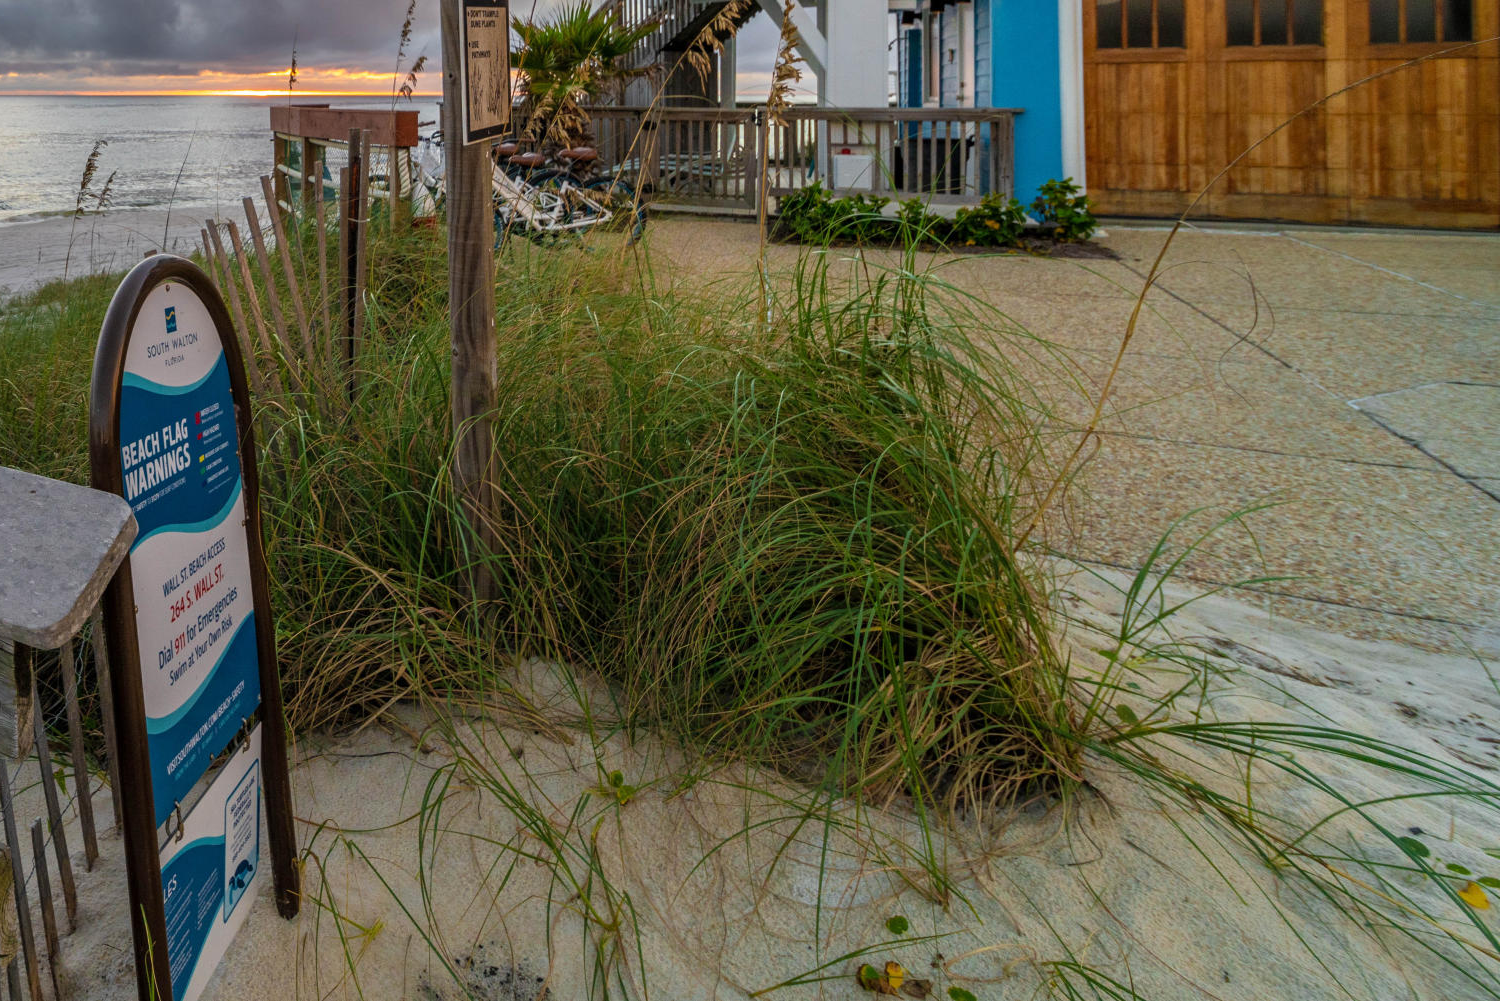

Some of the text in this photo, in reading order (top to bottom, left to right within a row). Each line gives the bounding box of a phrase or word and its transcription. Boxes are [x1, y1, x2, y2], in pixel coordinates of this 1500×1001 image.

[471, 20, 496, 28] DUNE PLANTS
[147, 332, 198, 358] SOUTH WALTON
[165, 354, 184, 367] FLORIDA
[122, 431, 160, 470] BEACH
[162, 418, 188, 449] FLAG
[125, 442, 191, 501] WARNINGS
[163, 537, 226, 598] WALL ST. BEACH ACCESS
[170, 563, 225, 623] 264 S. WALL ST.
[158, 587, 238, 670] Dial 911 for Emergencies
[170, 614, 233, 686] Swim at Your Own Risk
[163, 873, 177, 905] LES
